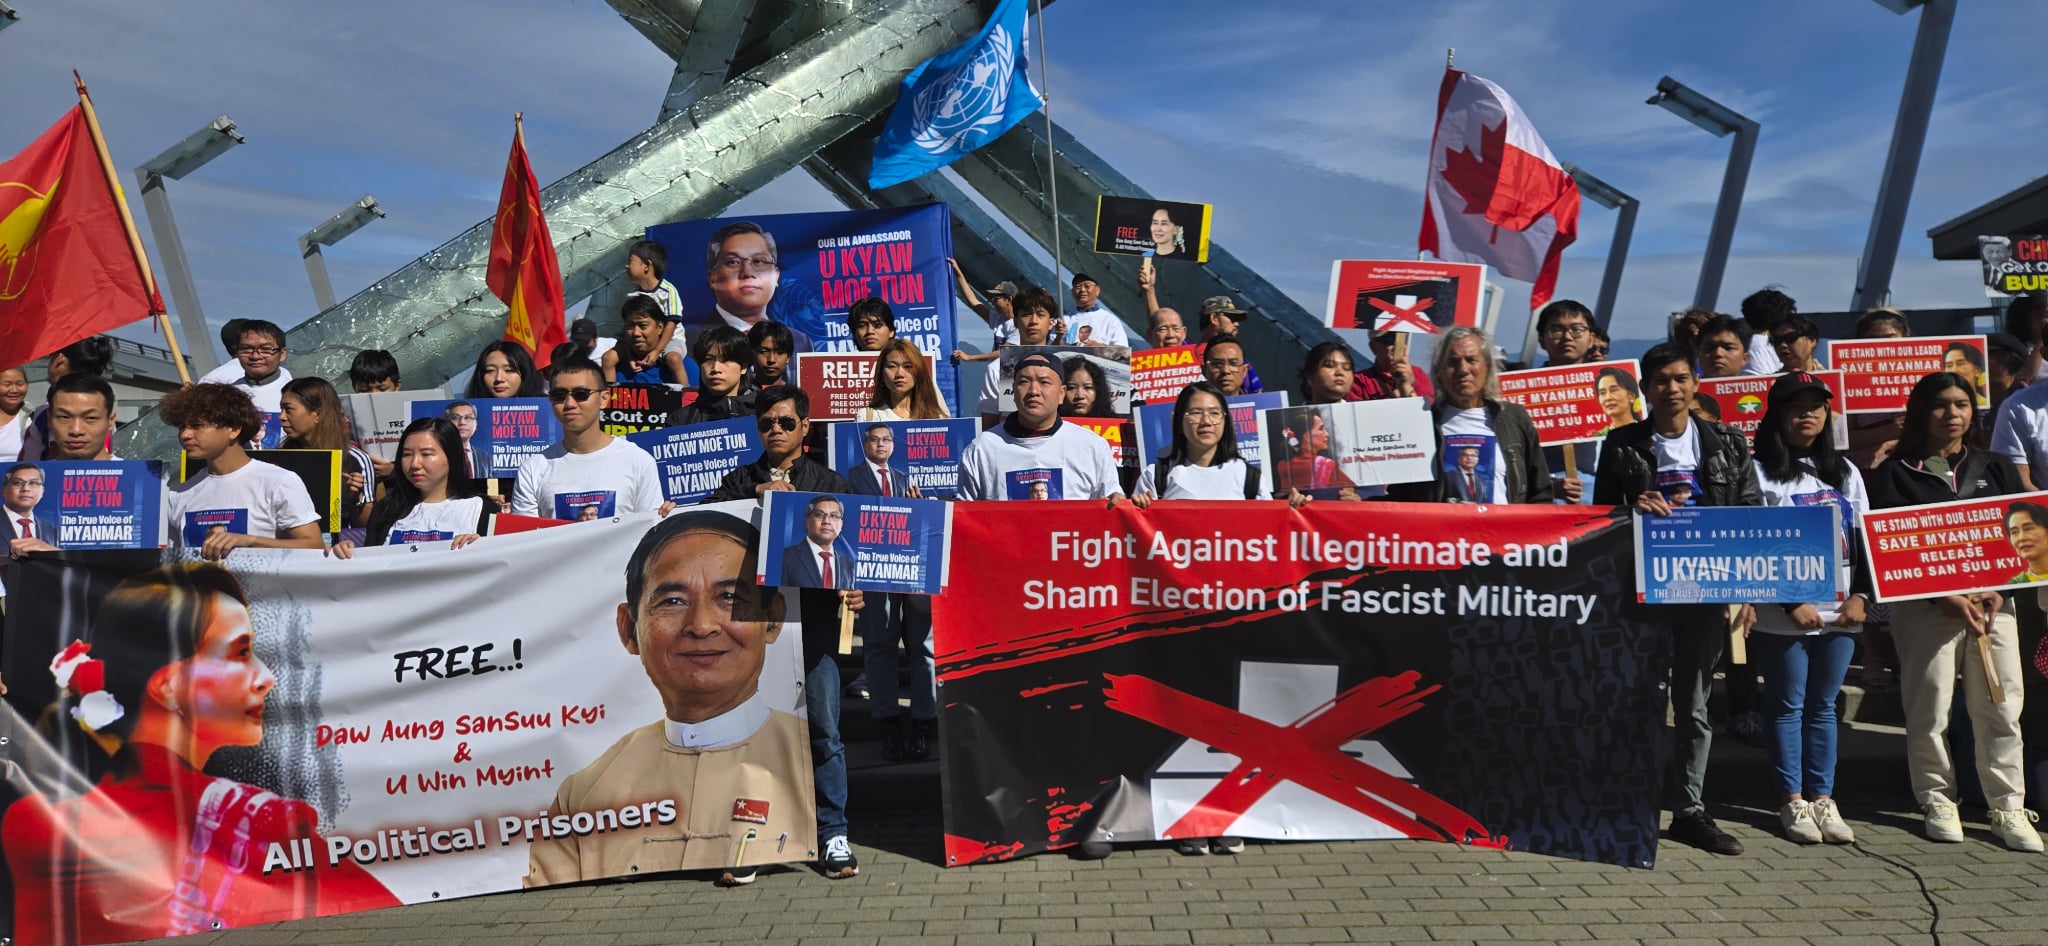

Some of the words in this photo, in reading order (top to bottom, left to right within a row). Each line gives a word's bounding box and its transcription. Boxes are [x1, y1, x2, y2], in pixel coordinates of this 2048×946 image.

[818, 238, 836, 249] OUR
[837, 236, 850, 246] UN
[852, 230, 912, 245] AMBASSADOR
[1117, 227, 1139, 238] FREE
[2018, 240, 2048, 260] CHI
[820, 252, 836, 278] U
[842, 242, 912, 275] KYAW
[2001, 262, 2032, 273] Get
[878, 274, 924, 303] TUN
[2006, 275, 2048, 290] BUR
[825, 321, 849, 338] The
[894, 316, 921, 333] oice
[924, 315, 938, 331] of
[1839, 349, 1850, 359] WE
[1852, 348, 1874, 358] STAND
[1877, 347, 1895, 358] WITH
[1898, 346, 1912, 356] OUR
[1915, 345, 1942, 355] LEADER
[1152, 365, 1202, 376] INTERFE
[1841, 363, 1873, 373] SAVE
[1878, 360, 1941, 371] MYANMAR
[822, 379, 843, 388] ALL
[1154, 374, 1208, 388] INTERNA
[1502, 379, 1526, 391] STAND
[1528, 376, 1546, 387] WITH
[1550, 375, 1564, 386] OUR
[1566, 371, 1594, 384] LEADER
[1716, 381, 1767, 395] RETURN
[607, 387, 649, 410] HINA
[1131, 387, 1181, 401] AFFAIR
[1530, 387, 1594, 402] MYANMAR
[1876, 388, 1899, 396] SAN
[492, 413, 499, 425] U
[502, 412, 536, 424] KYAW
[611, 411, 643, 423] Out
[648, 413, 667, 423] of
[1231, 407, 1252, 420] YAW
[1558, 416, 1582, 426] SUU
[1586, 413, 1608, 424] KYI
[493, 425, 516, 438] MOE
[519, 425, 539, 438] TUN
[668, 434, 680, 442] OUR
[690, 428, 728, 439] AMBASSADOR
[907, 434, 914, 445] U
[916, 433, 946, 445] KYAW
[493, 445, 505, 453] The
[522, 445, 540, 453] Voice
[653, 445, 662, 460] U
[664, 440, 698, 458] KYAW
[699, 436, 722, 453] MOE
[725, 433, 747, 449] TUN
[908, 447, 928, 459] MOE
[931, 446, 949, 458] TUN
[666, 464, 681, 475] The
[684, 461, 703, 473] True
[705, 457, 727, 469] Voice
[729, 456, 738, 466] of
[908, 466, 919, 474] The
[951, 464, 958, 472] of
[63, 477, 74, 491] U
[76, 477, 118, 491] KYAW
[909, 473, 958, 486] MYANMAR
[62, 492, 91, 507] MOE
[96, 492, 122, 507] TUN
[62, 515, 77, 524] The
[78, 515, 97, 524] True
[99, 515, 122, 524] Voice
[123, 515, 133, 524] of
[859, 512, 869, 527] U
[871, 513, 908, 529] KYAW
[1873, 520, 1887, 533] WE
[1889, 516, 1918, 531] STAND
[1920, 514, 1943, 528] WITH
[1946, 512, 1964, 525] OUR
[1967, 507, 2003, 522] LEADER
[60, 526, 133, 541] MYANMAR
[859, 528, 883, 544] MOE
[888, 530, 910, 545] TUN
[1651, 531, 1676, 539] OUR
[1686, 530, 1701, 539] UN
[1711, 529, 1801, 539] AMBASSADOR
[1879, 535, 1919, 550] SAVE
[1925, 526, 2004, 546] MYANMAR
[858, 552, 871, 561] The
[872, 553, 889, 562] True
[890, 553, 911, 563] Voice
[911, 555, 919, 563] of
[1051, 530, 1137, 569] Fight
[1147, 530, 1278, 569] Against
[1290, 530, 1491, 571] Illegitimate
[1503, 536, 1568, 569] and
[1920, 546, 1984, 563] RELEASE
[856, 562, 919, 580] MYANMAR
[1653, 557, 1668, 582] U
[1672, 556, 1730, 581] KYAW
[1736, 556, 1779, 581] MOE
[1783, 556, 1825, 581] TUN
[1884, 567, 1923, 581] AUNG
[1928, 562, 1957, 577] SAN
[1961, 560, 1991, 573] SUU
[1996, 556, 2022, 569] KYI
[1654, 589, 1668, 599] THE
[1672, 589, 1692, 598] TRUE
[1694, 588, 1719, 598] VOICE
[1722, 588, 1731, 598] OF
[1735, 588, 1777, 598] MYANMAR
[1022, 579, 1119, 611] Sham
[1130, 577, 1267, 612] Election
[1277, 581, 1310, 612] of
[1321, 581, 1446, 617] Fascist
[1457, 583, 1597, 626] Military
[394, 638, 524, 684] FREE..!
[316, 723, 371, 748] Daw
[380, 717, 446, 744] Aung
[561, 703, 606, 726] Kyi
[453, 742, 472, 764] &
[385, 775, 407, 796] U
[418, 771, 467, 794] Win
[476, 759, 554, 790] Myint
[263, 837, 314, 876] All
[327, 819, 485, 865] Political
[499, 798, 677, 848] Prisoners
